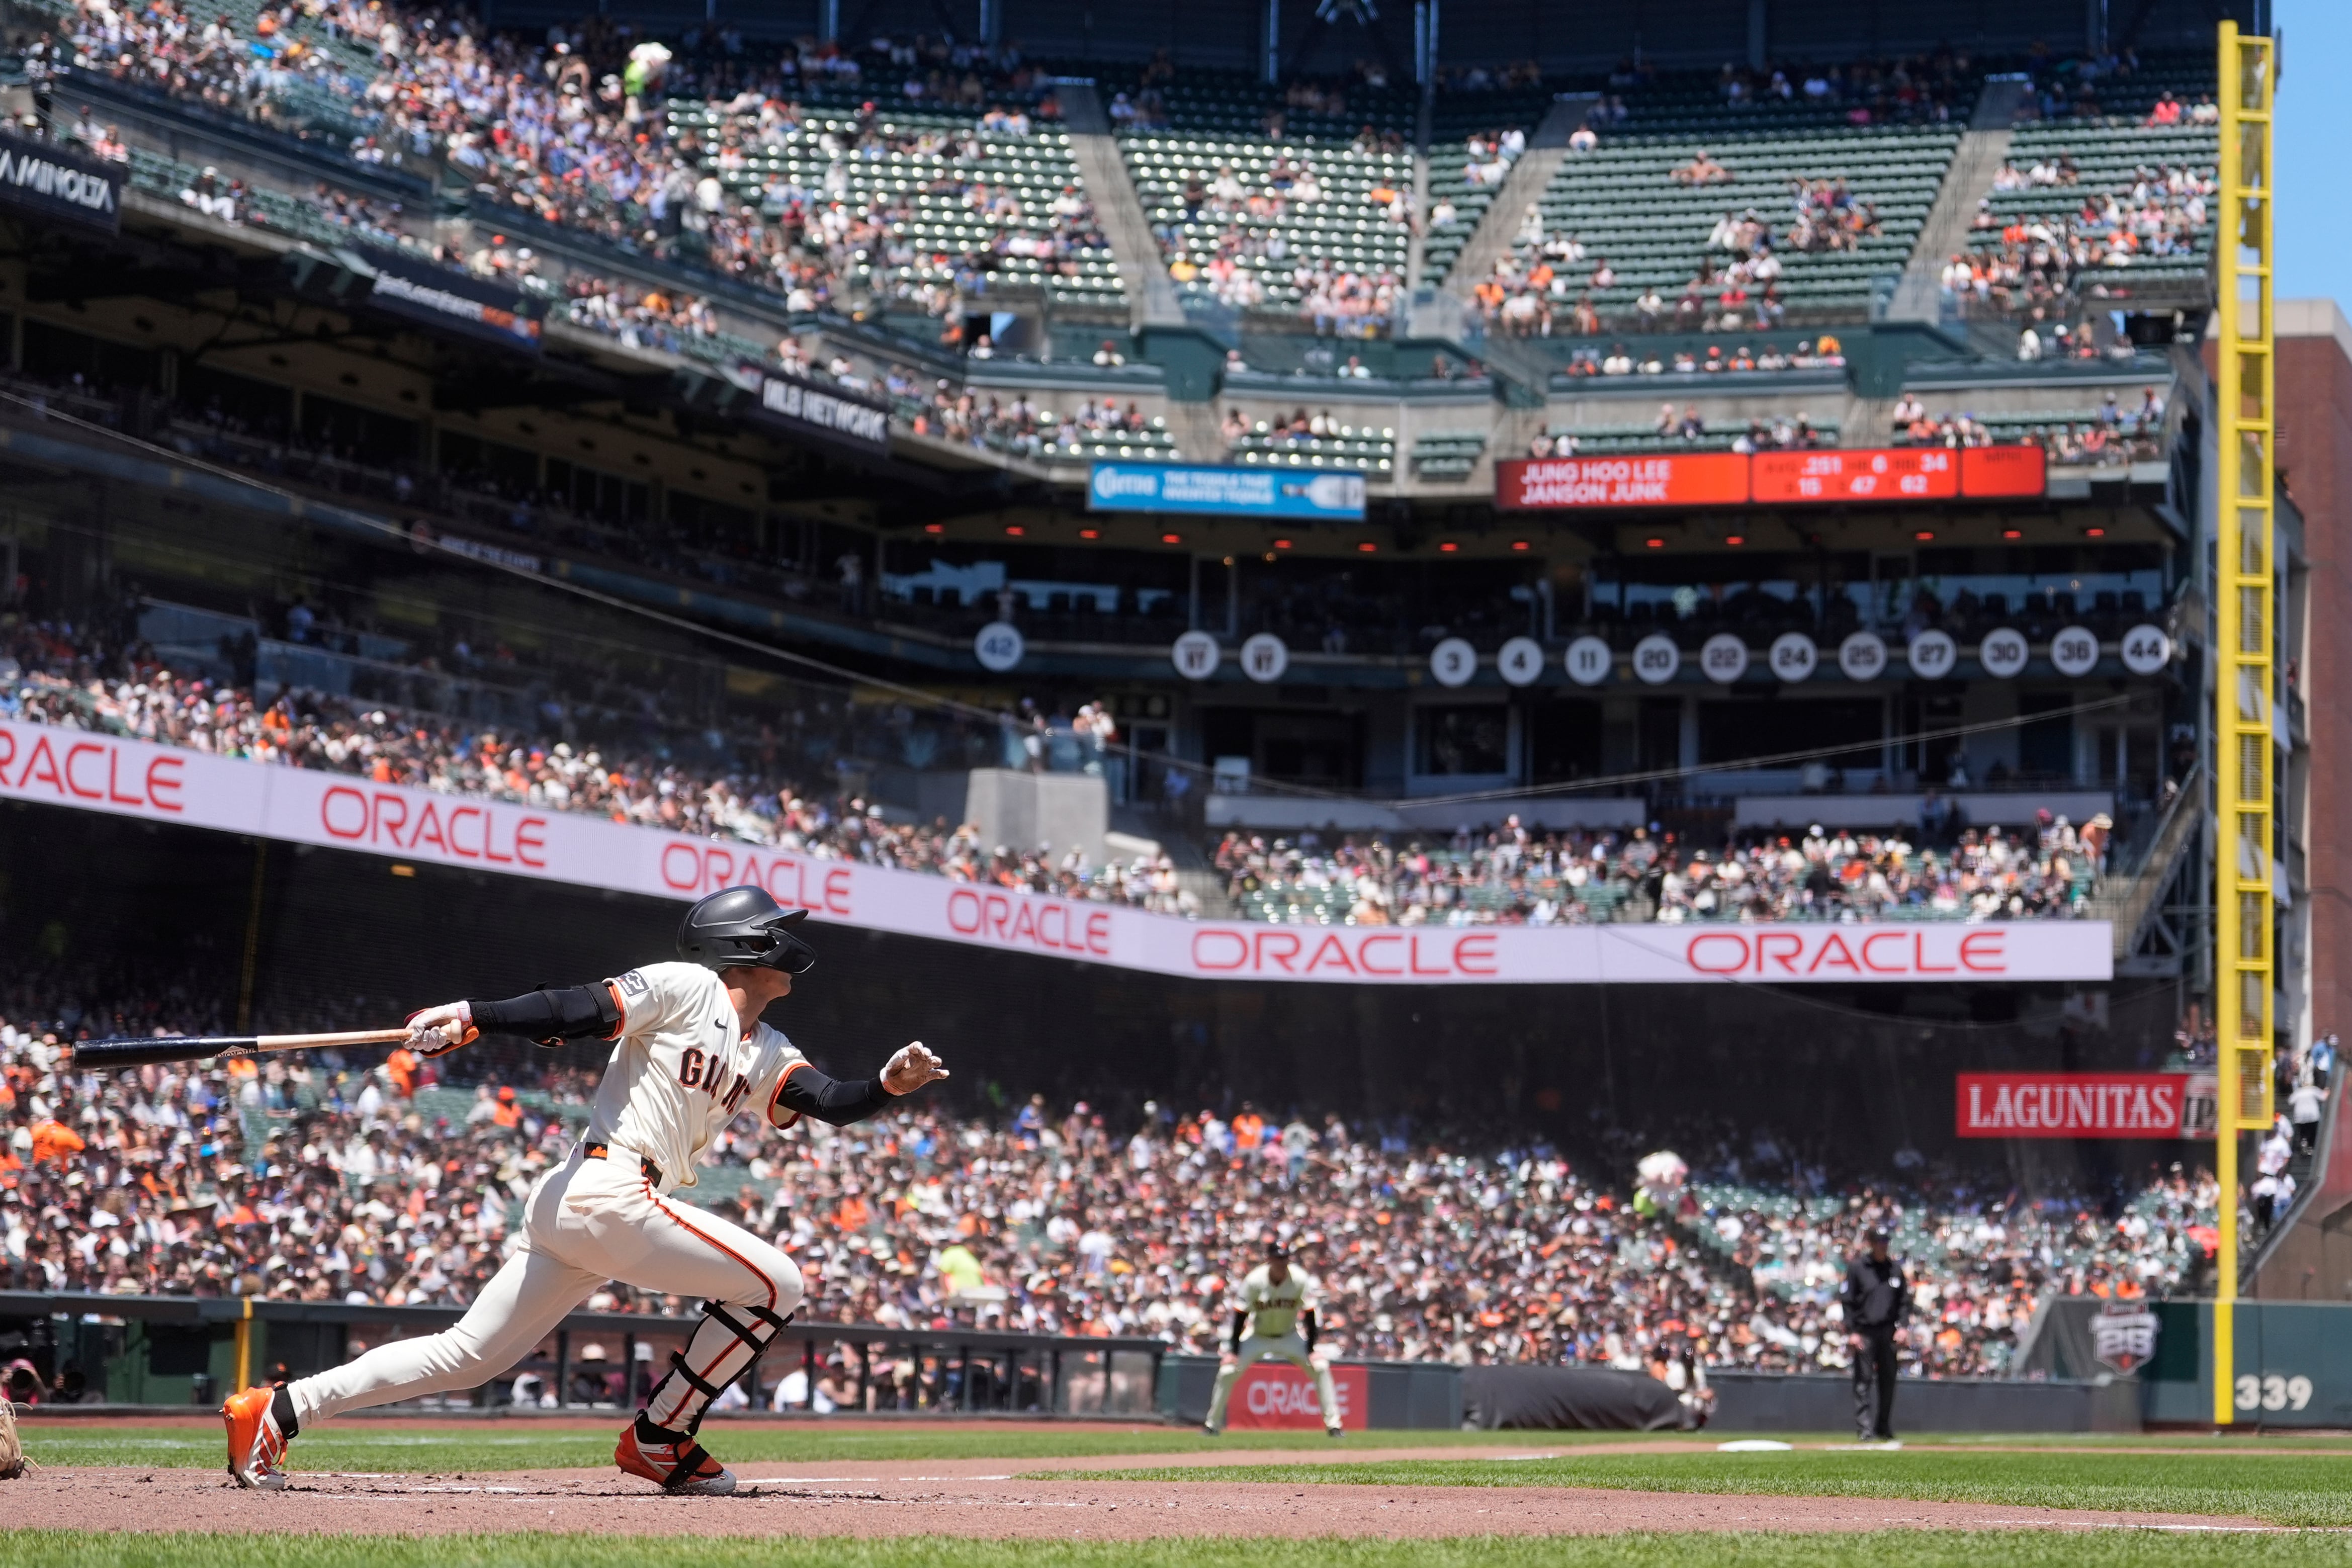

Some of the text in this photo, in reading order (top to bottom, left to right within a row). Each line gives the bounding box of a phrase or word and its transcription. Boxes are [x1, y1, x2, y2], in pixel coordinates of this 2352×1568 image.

[16, 154, 115, 214] MINOLTA
[802, 390, 887, 443] NETWORK
[1521, 459, 1672, 485] JUNG HOO LEE
[1920, 453, 1949, 473] 34
[1520, 481, 1668, 504] JANSON JUNK
[1850, 475, 1877, 494] 47
[1900, 474, 1928, 494] 62
[983, 636, 1014, 657] 42
[1779, 646, 1807, 668] 24
[1848, 644, 1879, 666] 25
[1918, 643, 1947, 664] 27
[1990, 642, 2020, 663] 30
[2129, 639, 2161, 658] 44
[1445, 652, 1461, 672] 3
[1512, 652, 1526, 670] 4
[1580, 650, 1597, 671] 11
[1641, 649, 1670, 669] 20
[1710, 647, 1738, 669] 22
[321, 785, 546, 867] ORACLE
[947, 889, 1109, 955] ORACLE
[1191, 929, 1498, 975] ORACLE
[1687, 930, 2007, 975] ORACLE
[1967, 1083, 2176, 1129] LAGUNITAS
[1247, 1379, 1351, 1416] ORACE
[2234, 1374, 2314, 1412] 339
